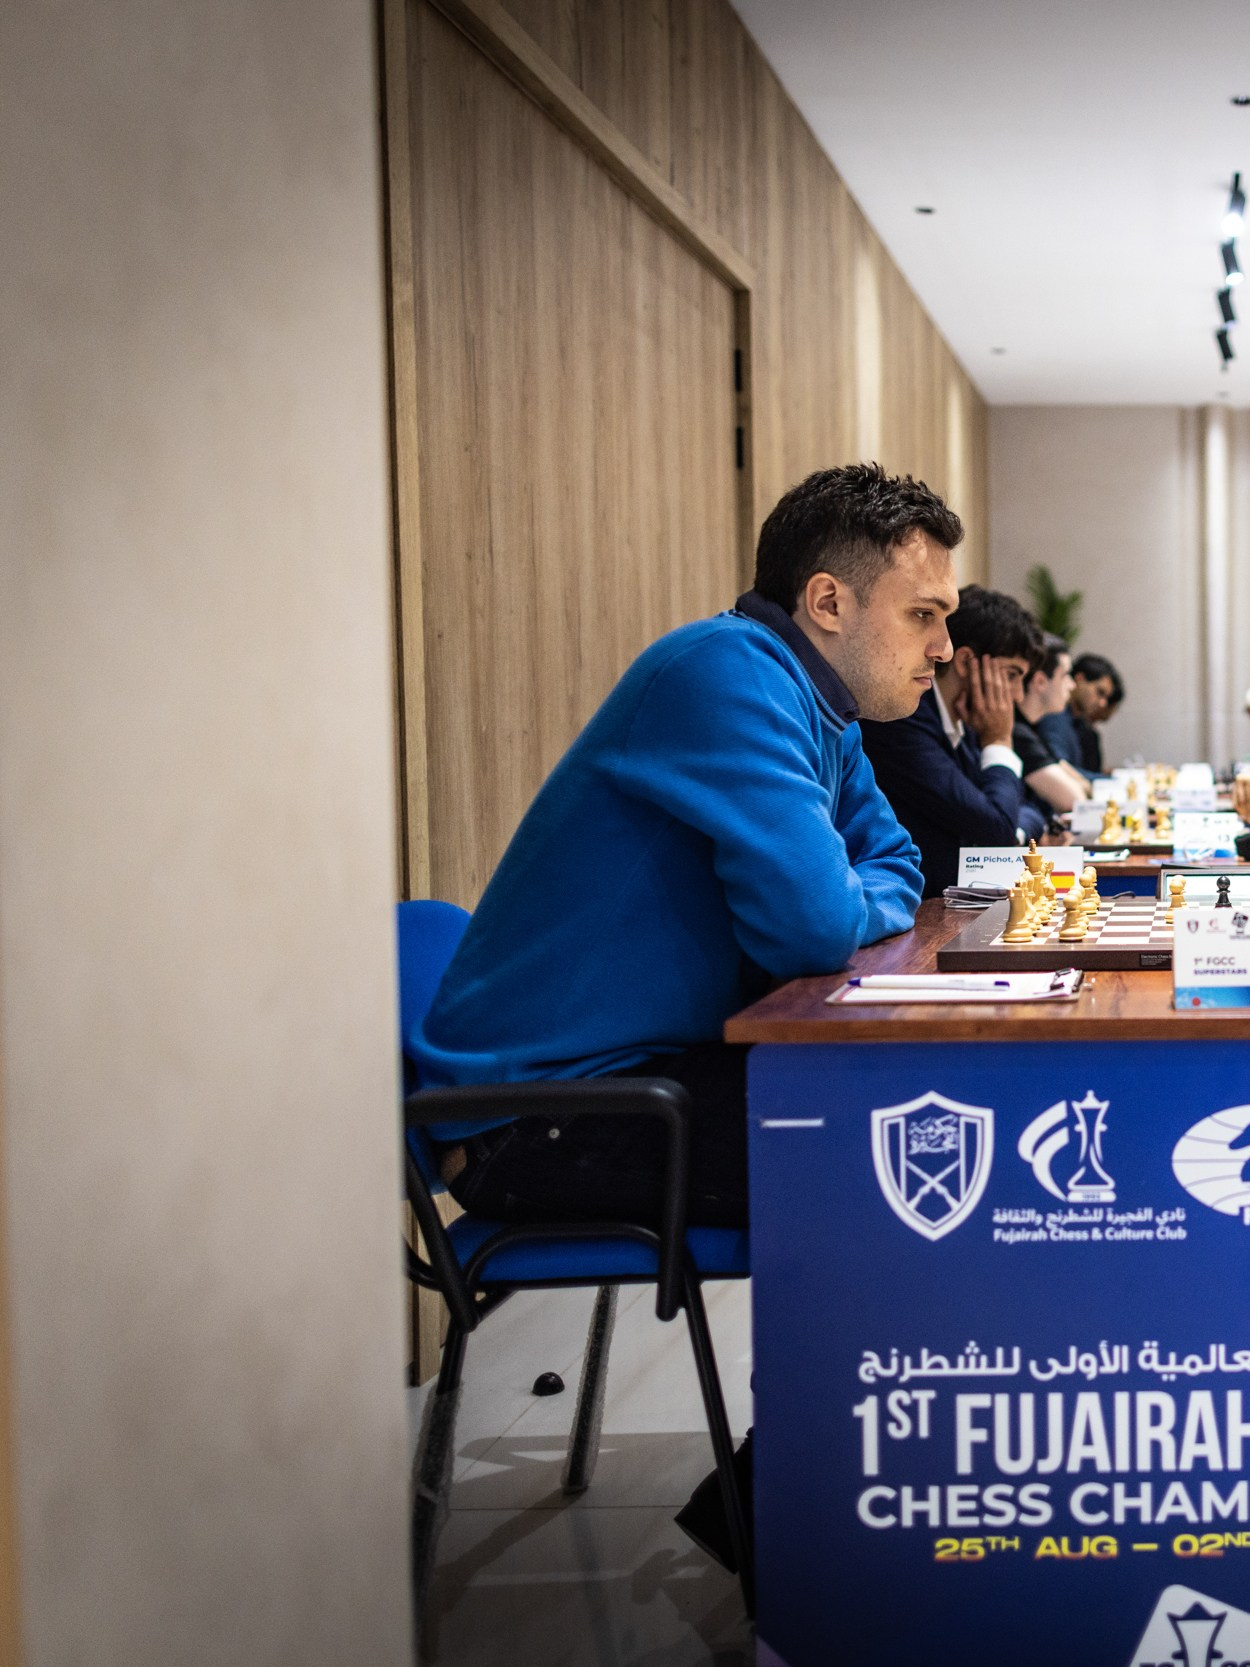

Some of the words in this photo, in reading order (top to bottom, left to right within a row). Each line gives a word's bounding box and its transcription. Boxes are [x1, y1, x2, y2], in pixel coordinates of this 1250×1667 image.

[983, 855, 1014, 864] Pichot,
[1193, 968, 1248, 976] SUPERSTARS
[1046, 1207, 1103, 1229] للشطرنج
[1106, 1207, 1153, 1225] الفجيرة
[1155, 1206, 1187, 1225] نادي
[993, 1228, 1048, 1244] Fujairah
[1050, 1228, 1089, 1241] Chess
[1091, 1227, 1103, 1240] &
[1105, 1227, 1154, 1240] Culture
[1156, 1226, 1188, 1240] Club
[858, 1340, 1021, 1384] للشطرنج
[1028, 1339, 1130, 1382] الأولى
[852, 1389, 937, 1477] 1ST
[857, 1482, 1054, 1529] CHESS
[934, 1535, 1020, 1562] 25TH
[1034, 1534, 1119, 1560] AUG
